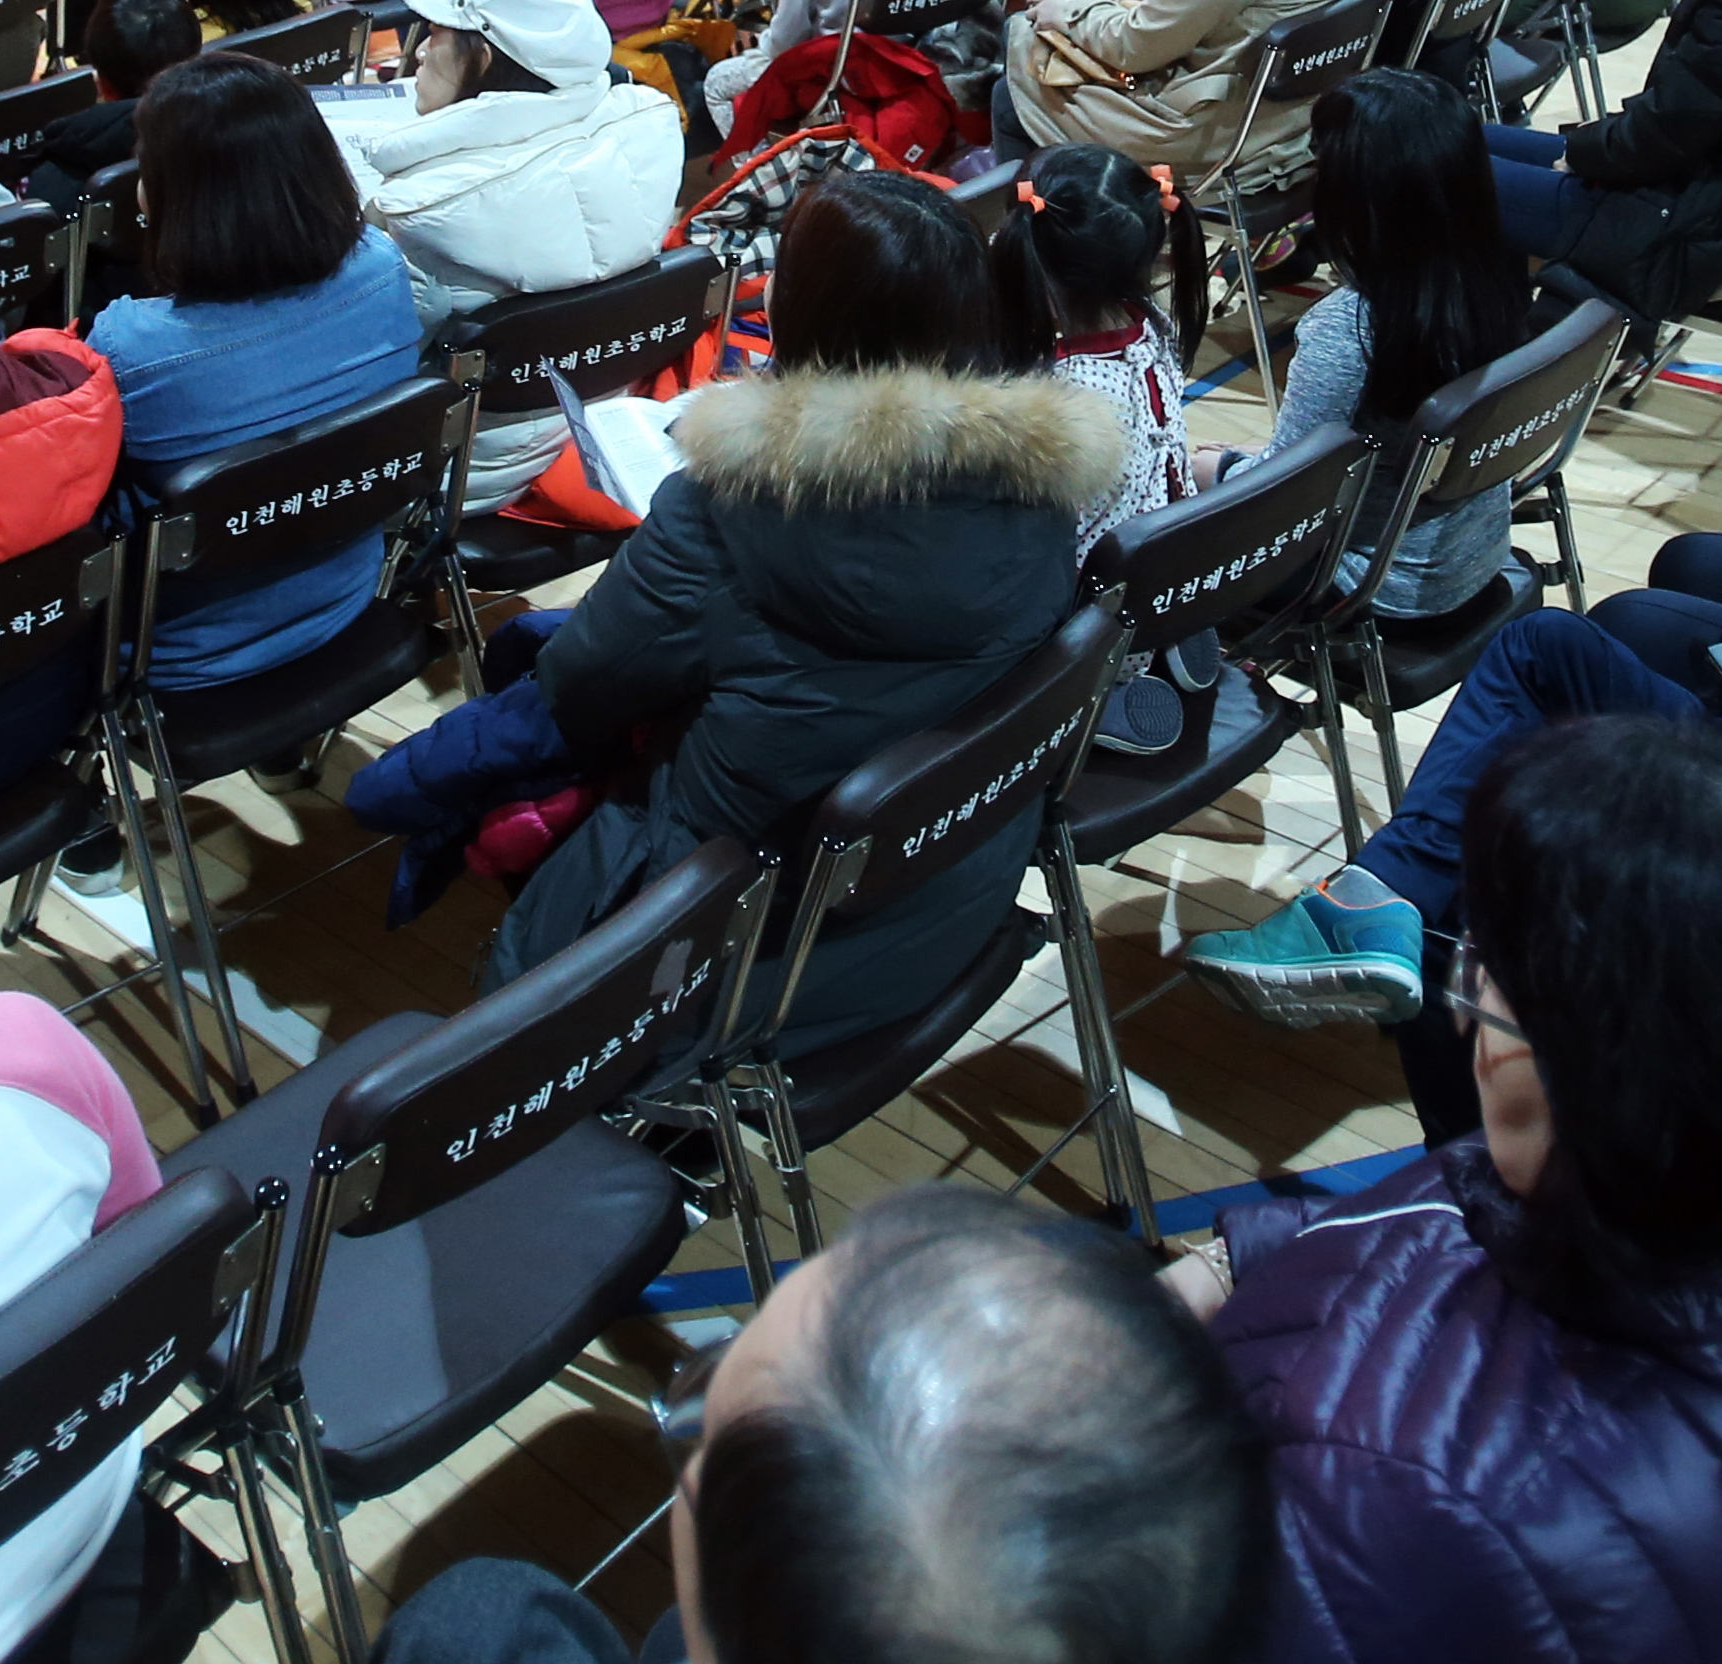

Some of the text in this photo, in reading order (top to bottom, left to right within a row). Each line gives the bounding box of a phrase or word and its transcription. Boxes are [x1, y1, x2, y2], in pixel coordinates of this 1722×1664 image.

[291, 48, 340, 75] 초등학교
[1293, 35, 1371, 74] 인천해원초등학교
[1469, 382, 1589, 468] 인천해원초등학교
[225, 451, 424, 537] 인천해원초등학교
[1151, 507, 1327, 614] 인천해원초등학교
[903, 707, 1084, 859] 인천해원초등학교
